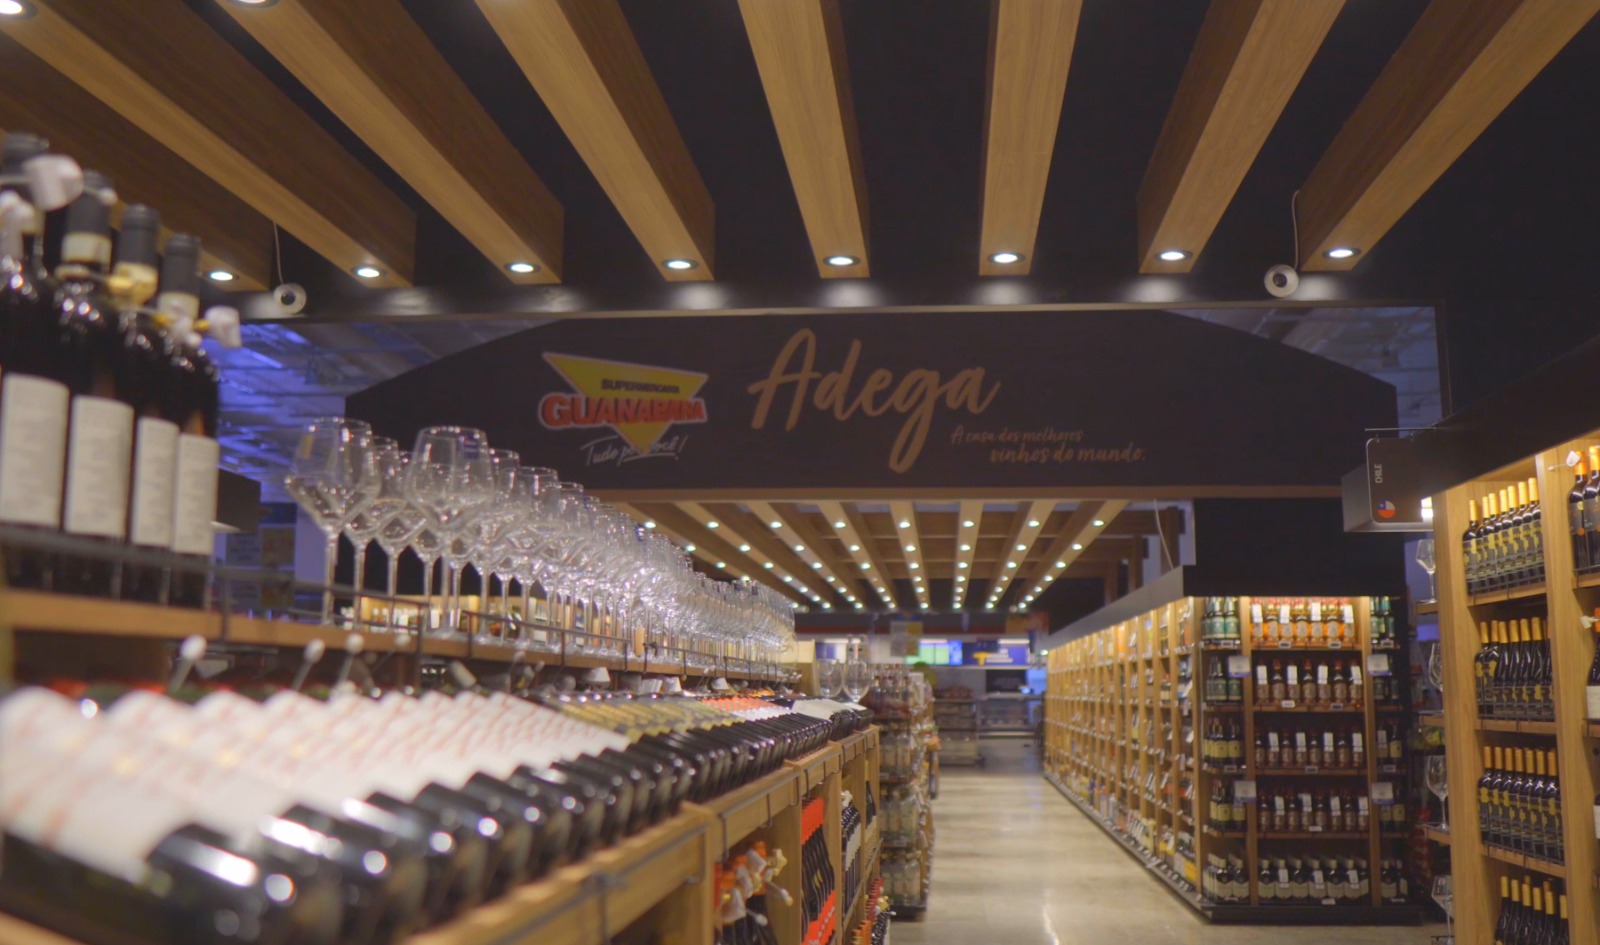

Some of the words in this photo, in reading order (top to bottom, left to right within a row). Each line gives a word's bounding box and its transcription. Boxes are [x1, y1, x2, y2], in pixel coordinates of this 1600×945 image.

[540, 394, 707, 429] GUANABARA
[747, 328, 1001, 473] Adega
[951, 424, 965, 444] A
[966, 431, 996, 444] casa
[580, 435, 619, 466] Tudo
[991, 443, 1050, 464] vinhos
[1374, 463, 1384, 484] CHILE
